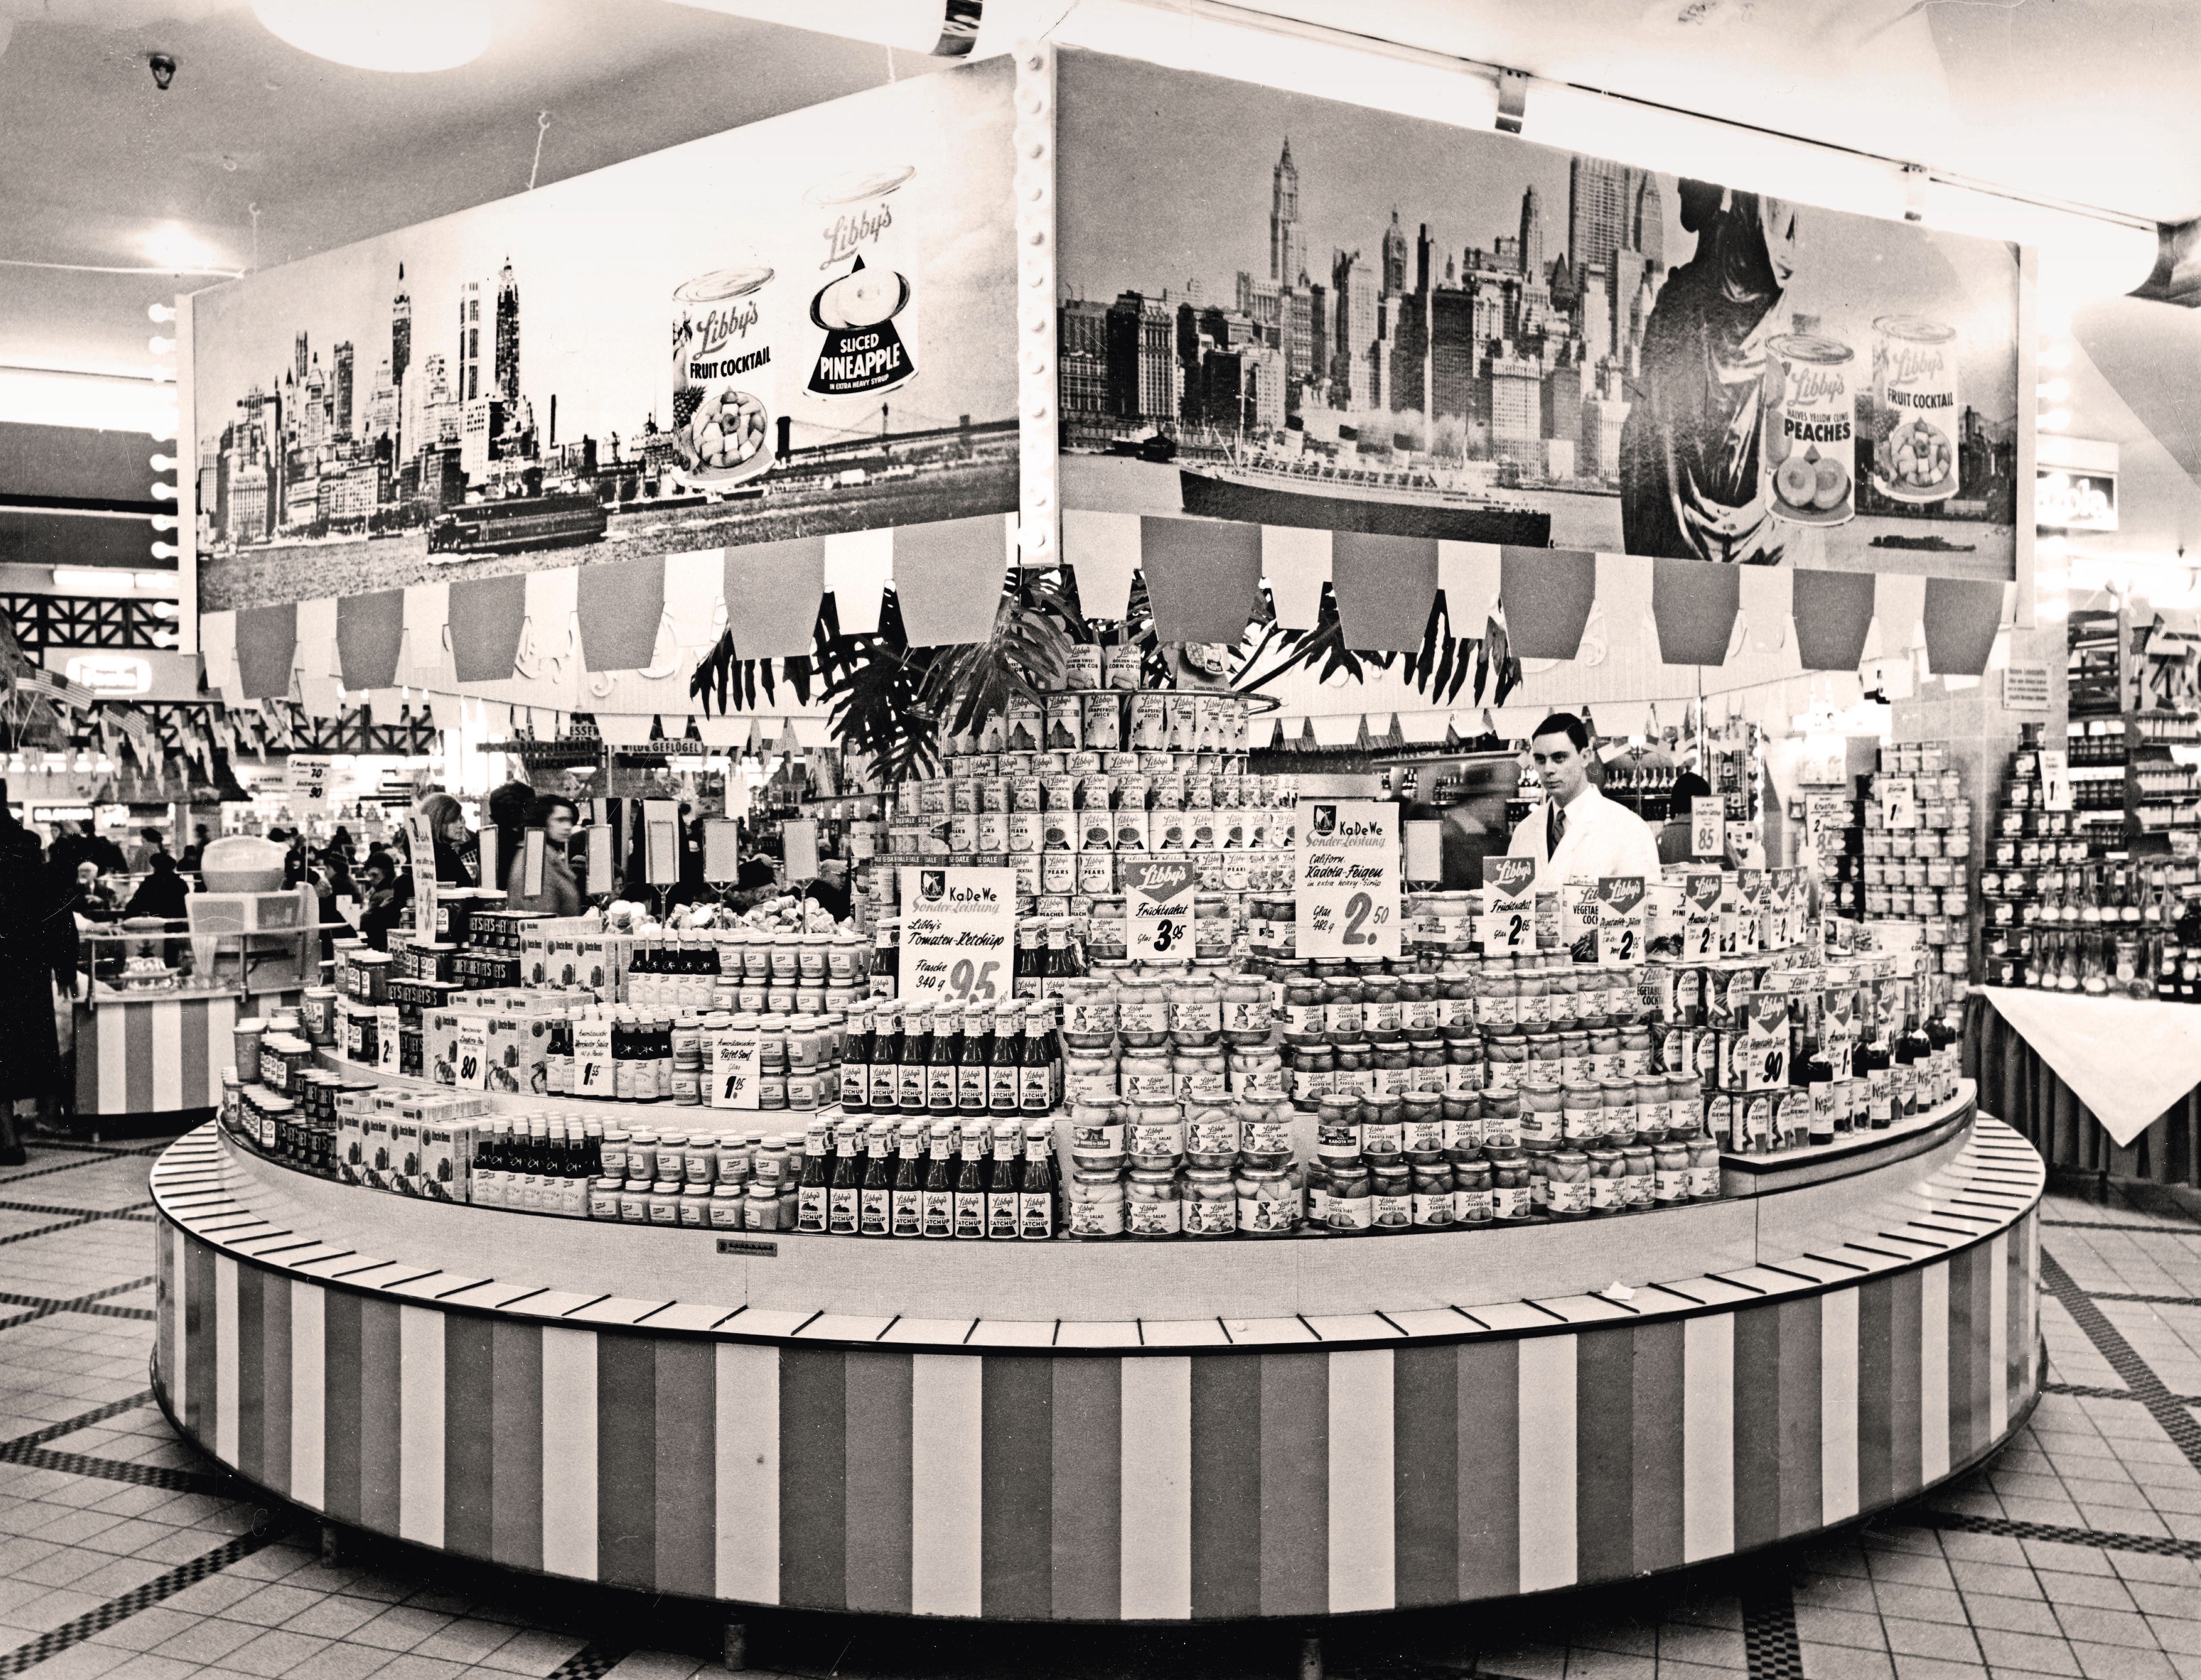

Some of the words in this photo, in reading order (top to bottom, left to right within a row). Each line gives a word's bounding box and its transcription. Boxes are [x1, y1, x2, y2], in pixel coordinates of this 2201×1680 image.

[820, 203, 892, 270] Libby's
[693, 301, 758, 361] Libby's
[840, 334, 879, 354] SLICED
[690, 361, 717, 380] FRUIT
[721, 346, 771, 378] COCKTAIL
[821, 342, 900, 380] PINEAPPLE
[1889, 347, 1945, 386] Libby's
[835, 381, 851, 389] EXTRA
[852, 378, 870, 388] HEAVY
[871, 374, 889, 386] SYRUP
[1787, 368, 1845, 406] Libby's
[1888, 387, 1911, 407] FRUIT
[1914, 392, 1953, 409] COCKTAIL
[1787, 408, 1807, 422] HALVES
[1810, 412, 1831, 422] YELLOW
[1834, 412, 1849, 422] CLING
[1784, 417, 1851, 442] PEACHES
[653, 741, 699, 753] GEFLÜGEL
[1340, 821, 1383, 836] KaDeWe
[1699, 828, 1714, 850] 85
[1048, 856, 1068, 867] Libby's
[1085, 856, 1104, 867] Libby's
[1135, 864, 1186, 890] Libby's
[1492, 860, 1531, 885] Libby's
[950, 887, 997, 901] KaDeWe
[1606, 879, 1640, 904] Libby's
[1692, 877, 1719, 900] Libby's
[1313, 905, 1331, 921] Glas
[1573, 905, 1599, 914] VEGETA
[908, 918, 941, 933] Libby's
[1313, 920, 1327, 931] 482
[1138, 933, 1151, 944] Glas
[1494, 930, 1506, 939] Glas
[915, 959, 948, 972] Flasche
[916, 975, 936, 988] 340
[938, 980, 945, 991] g
[1755, 995, 1785, 1022] Libby's
[461, 1055, 476, 1079] 80
[1762, 1051, 1783, 1082] 90
[931, 1070, 949, 1080] Libby's
[961, 1070, 980, 1081] Libby's
[992, 1070, 1012, 1081] Libby's
[1025, 1070, 1044, 1081] Libby's
[1145, 1127, 1164, 1136] Libby's
[832, 1192, 851, 1203] Libby's
[896, 1195, 917, 1206] Libby's
[926, 1196, 947, 1207] Libby's
[958, 1196, 979, 1208] Libby's
[992, 1197, 1013, 1208] Libby's
[1024, 1197, 1046, 1209] Libby's
